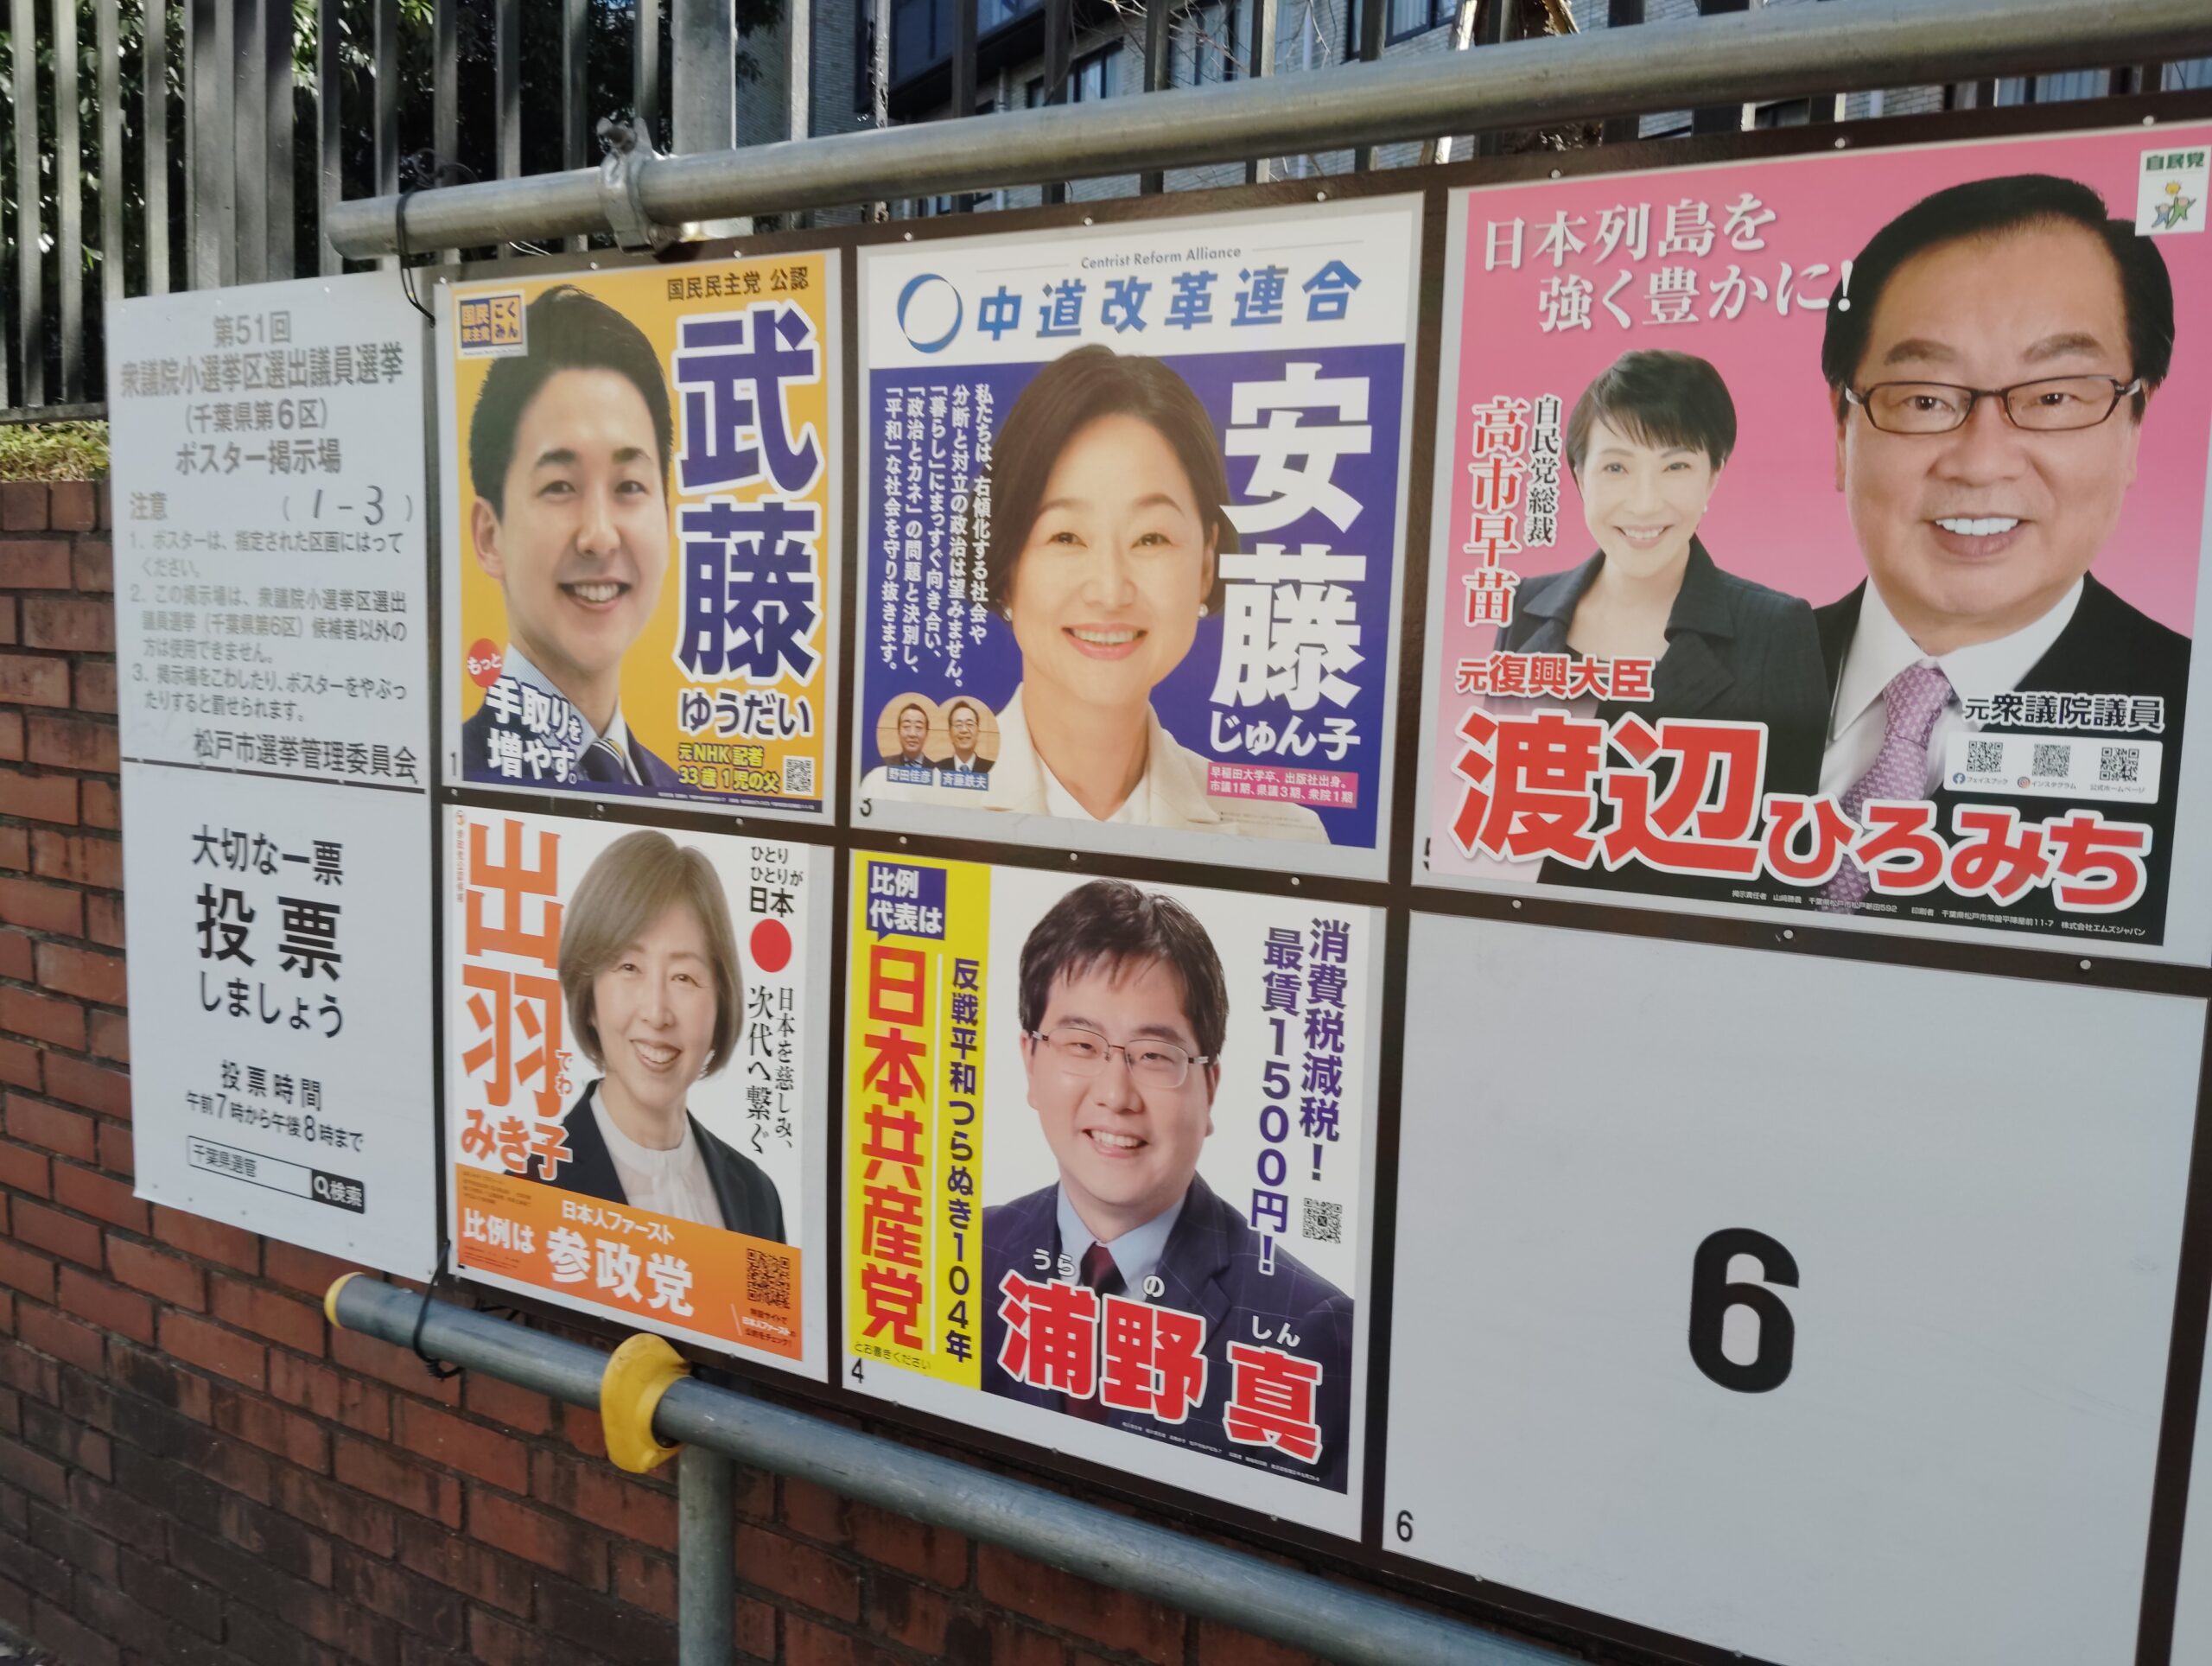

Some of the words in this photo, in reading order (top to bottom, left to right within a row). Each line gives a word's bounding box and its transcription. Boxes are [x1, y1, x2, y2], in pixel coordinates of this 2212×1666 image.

[2145, 152, 2204, 171] 自民党
[1081, 253, 1129, 270] Centrist
[1134, 250, 1182, 266] Reform
[1185, 246, 1242, 263] Alliance
[1483, 193, 1777, 271] 日本列島を
[667, 271, 760, 302] 国民民主党
[771, 266, 808, 290] 公認
[977, 260, 1362, 340] 中道改革連合
[1539, 260, 1853, 334] 強く豊かに!
[213, 311, 290, 348] 第51回
[120, 342, 404, 397] 衆議院小選挙区選出議員選挙
[186, 397, 327, 435] (千葉県第6区)
[175, 438, 341, 476] ポスター掲示場
[1526, 396, 1560, 546] 自民党総裁
[130, 491, 168, 520] 注意
[673, 302, 823, 683] 武藤
[969, 384, 994, 645] 私たちは、右傾化する社会や
[1465, 397, 1529, 628] 高市早苗
[880, 387, 903, 671] 「平和」な社会を守り抜きます。
[902, 386, 925, 673] 「政治とカネ」の問題と決別し、
[924, 386, 948, 658] 「暮らし」にまっすぐ向き合い、
[945, 384, 970, 688] 分断と対立の政治は望みません。
[1210, 363, 1372, 710] 安藤
[467, 653, 502, 675] もっと
[1456, 653, 1655, 701] 元復興大臣
[486, 677, 582, 741] 手取りを
[679, 690, 813, 738] ゆうだい
[1211, 710, 1361, 760] じゅん子
[1964, 693, 2164, 732] 元衆議院議員
[193, 728, 418, 783] 松戸市選挙管理委員会
[450, 752, 456, 776] 1
[888, 768, 931, 783] 野田佳彦
[1211, 766, 1346, 788] 早稲田大学卒、出版社出身。
[1211, 781, 1353, 803] 市議1期、県議3期、衆院1期
[1447, 708, 2156, 912] 渡辺ひろみち
[192, 824, 343, 886] 大切な一票
[751, 845, 788, 864] ひとり
[751, 866, 803, 886] ひとりが
[749, 887, 794, 918] 日本
[869, 866, 918, 900] 比例
[196, 883, 342, 982] 投票
[869, 900, 943, 934] 代表は
[462, 818, 564, 1118] 出羽
[200, 971, 343, 1039] しましょう
[555, 1049, 574, 1097] でわ
[747, 985, 774, 1154] 次代へ繋ぐ
[775, 986, 795, 1148] 日本を慈しみ、
[1299, 918, 1351, 1181] 消費税減税!
[222, 1059, 321, 1111] 投票時間
[1251, 926, 1304, 1275] 最賃1500円!
[186, 1090, 364, 1153] 午前7時から午後8時まで
[461, 1109, 573, 1181] みき子
[861, 944, 926, 1351] 日本共産党
[944, 957, 980, 1363] 反戦平和つらぬき104年
[562, 1200, 675, 1245] 日本人ファースト
[463, 1208, 535, 1254] 比例は
[547, 1226, 694, 1317] 参政党
[1033, 1249, 1077, 1279] うら
[1251, 1315, 1300, 1348] しん
[1688, 1227, 1799, 1393] 6
[851, 1358, 864, 1383] 4
[999, 1269, 1208, 1422] 浦野
[1225, 1341, 1323, 1464] 真
[1396, 1510, 1414, 1541] 6
